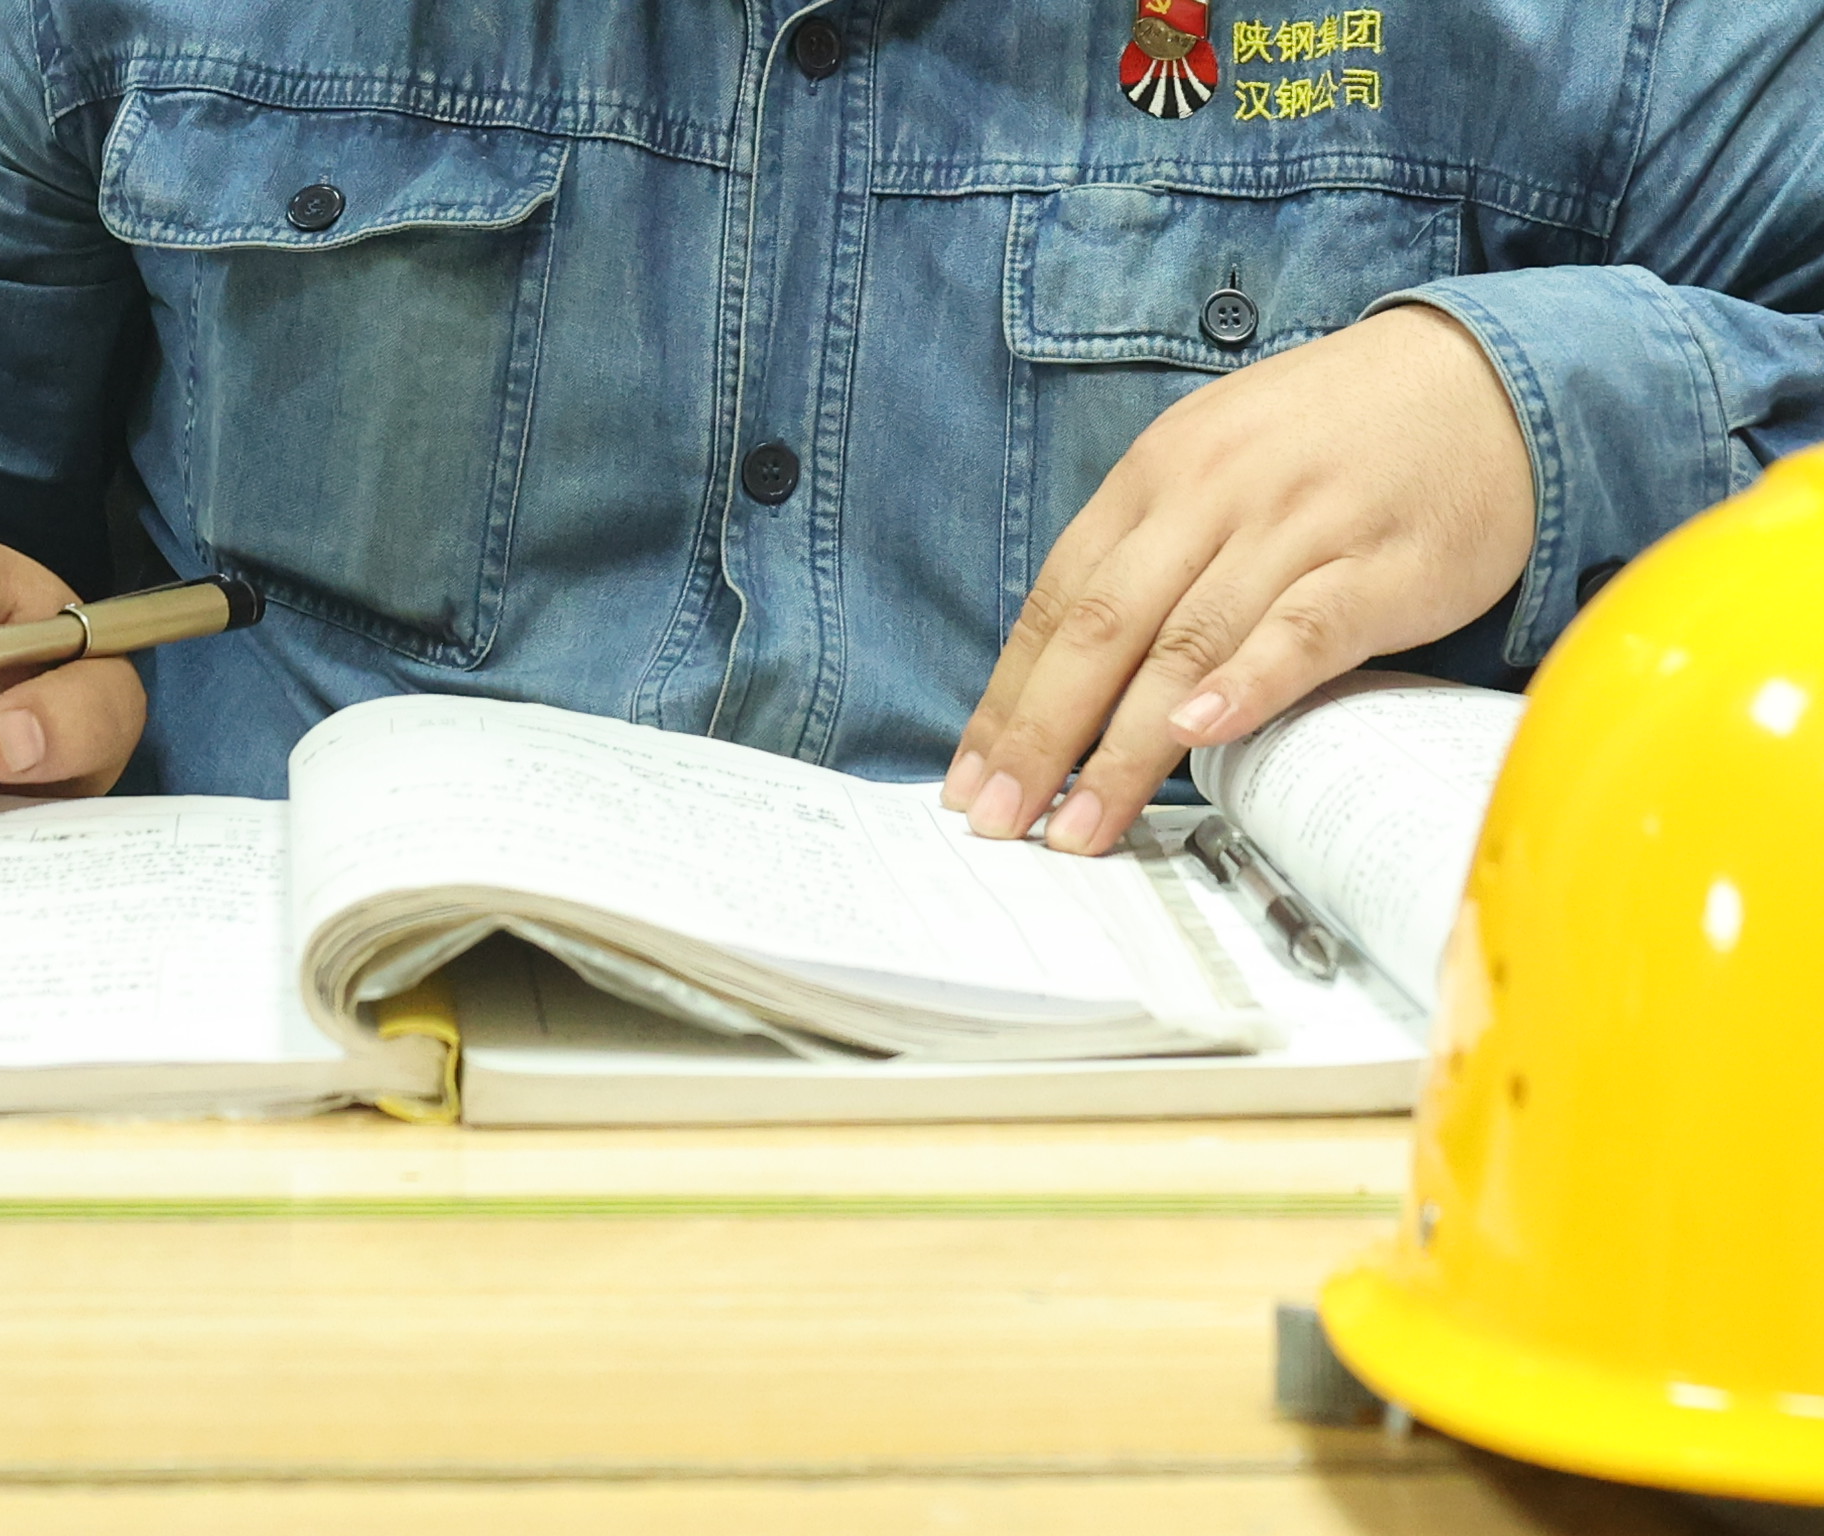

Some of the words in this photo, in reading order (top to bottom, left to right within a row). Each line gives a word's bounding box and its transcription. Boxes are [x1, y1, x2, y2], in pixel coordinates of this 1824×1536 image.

[1232, 9, 1382, 64] 陕钢集团
[1234, 68, 1382, 121] 汉钢公司
